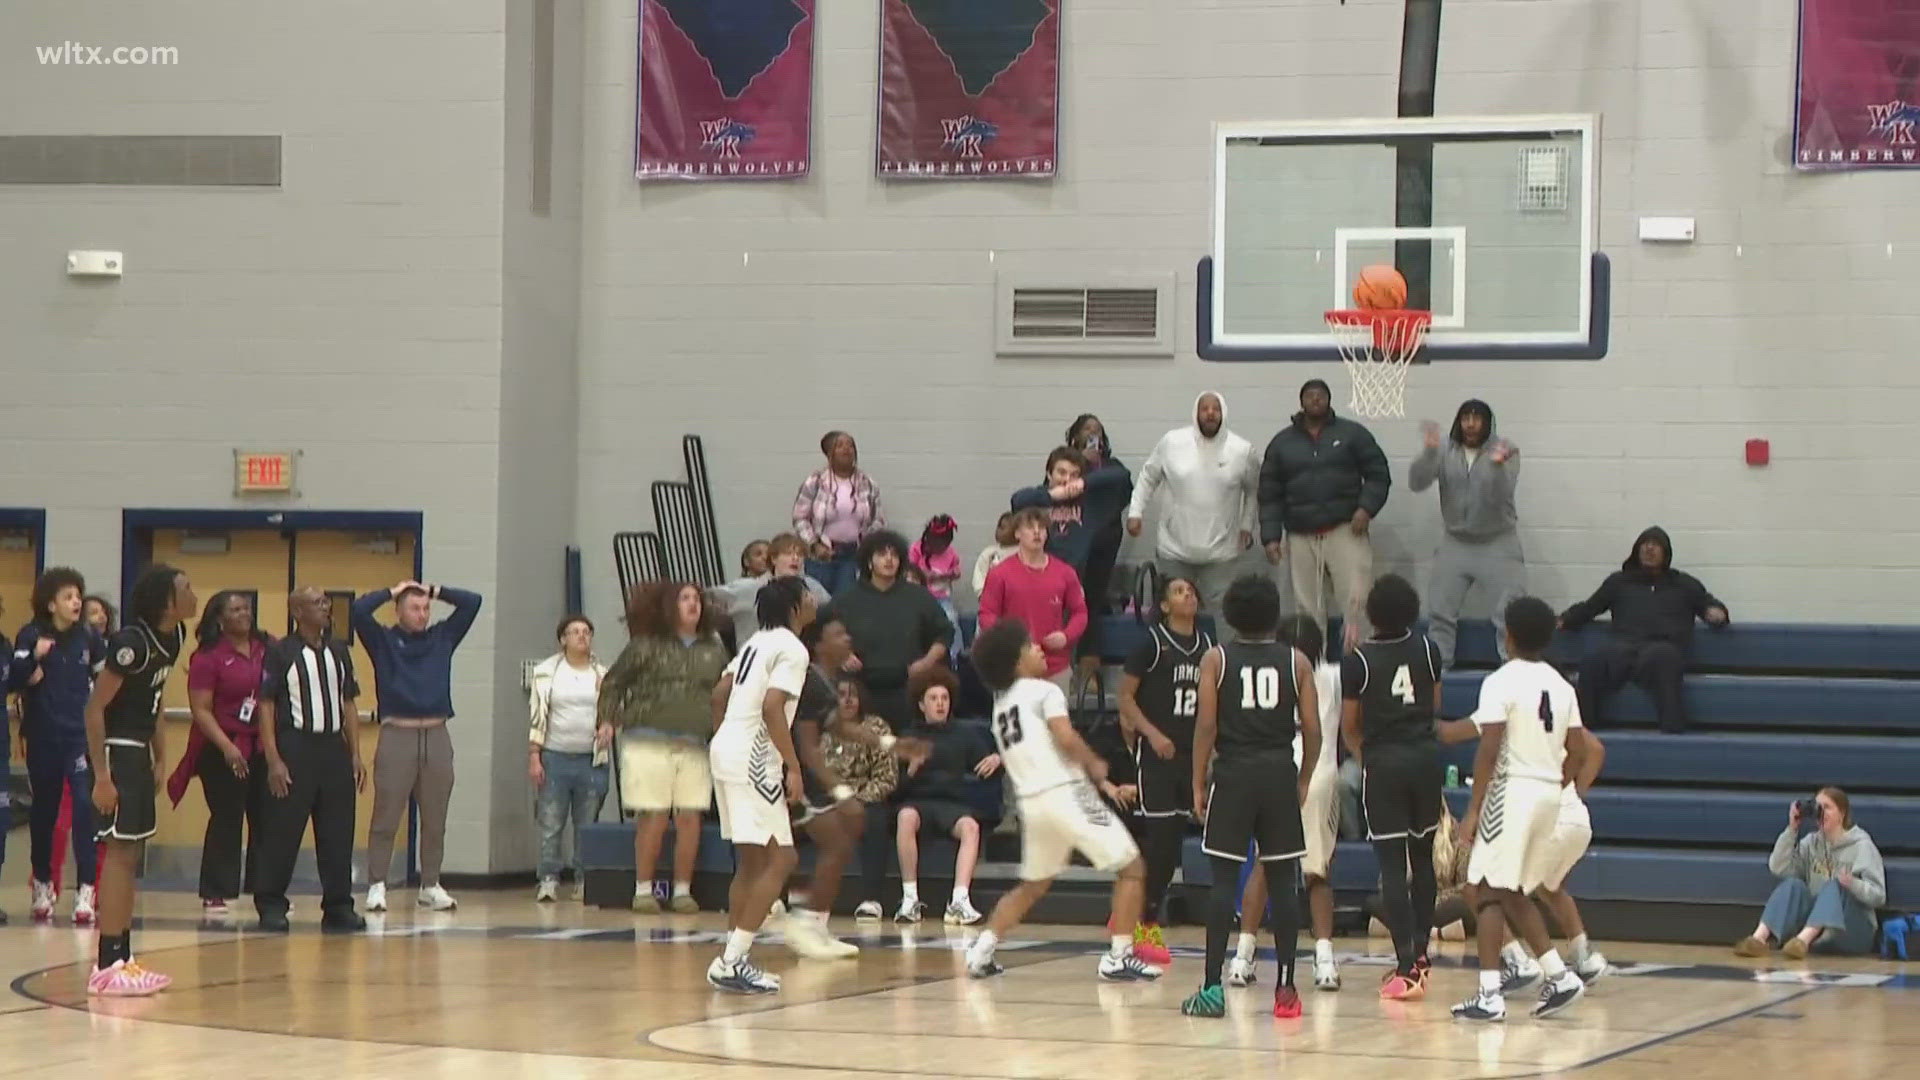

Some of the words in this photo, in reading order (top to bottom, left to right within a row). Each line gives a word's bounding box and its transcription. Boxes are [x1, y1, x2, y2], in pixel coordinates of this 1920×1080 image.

[641, 161, 806, 175] TIMBERWOLVES
[882, 159, 1053, 174] TIMBERWOLVES
[248, 458, 281, 485] EXIT
[735, 645, 758, 685] 11
[1391, 664, 1416, 704] 4
[1173, 687, 1197, 716] 12
[1240, 666, 1279, 709] 10
[998, 703, 1023, 751] 23
[1538, 689, 1554, 733] 4
